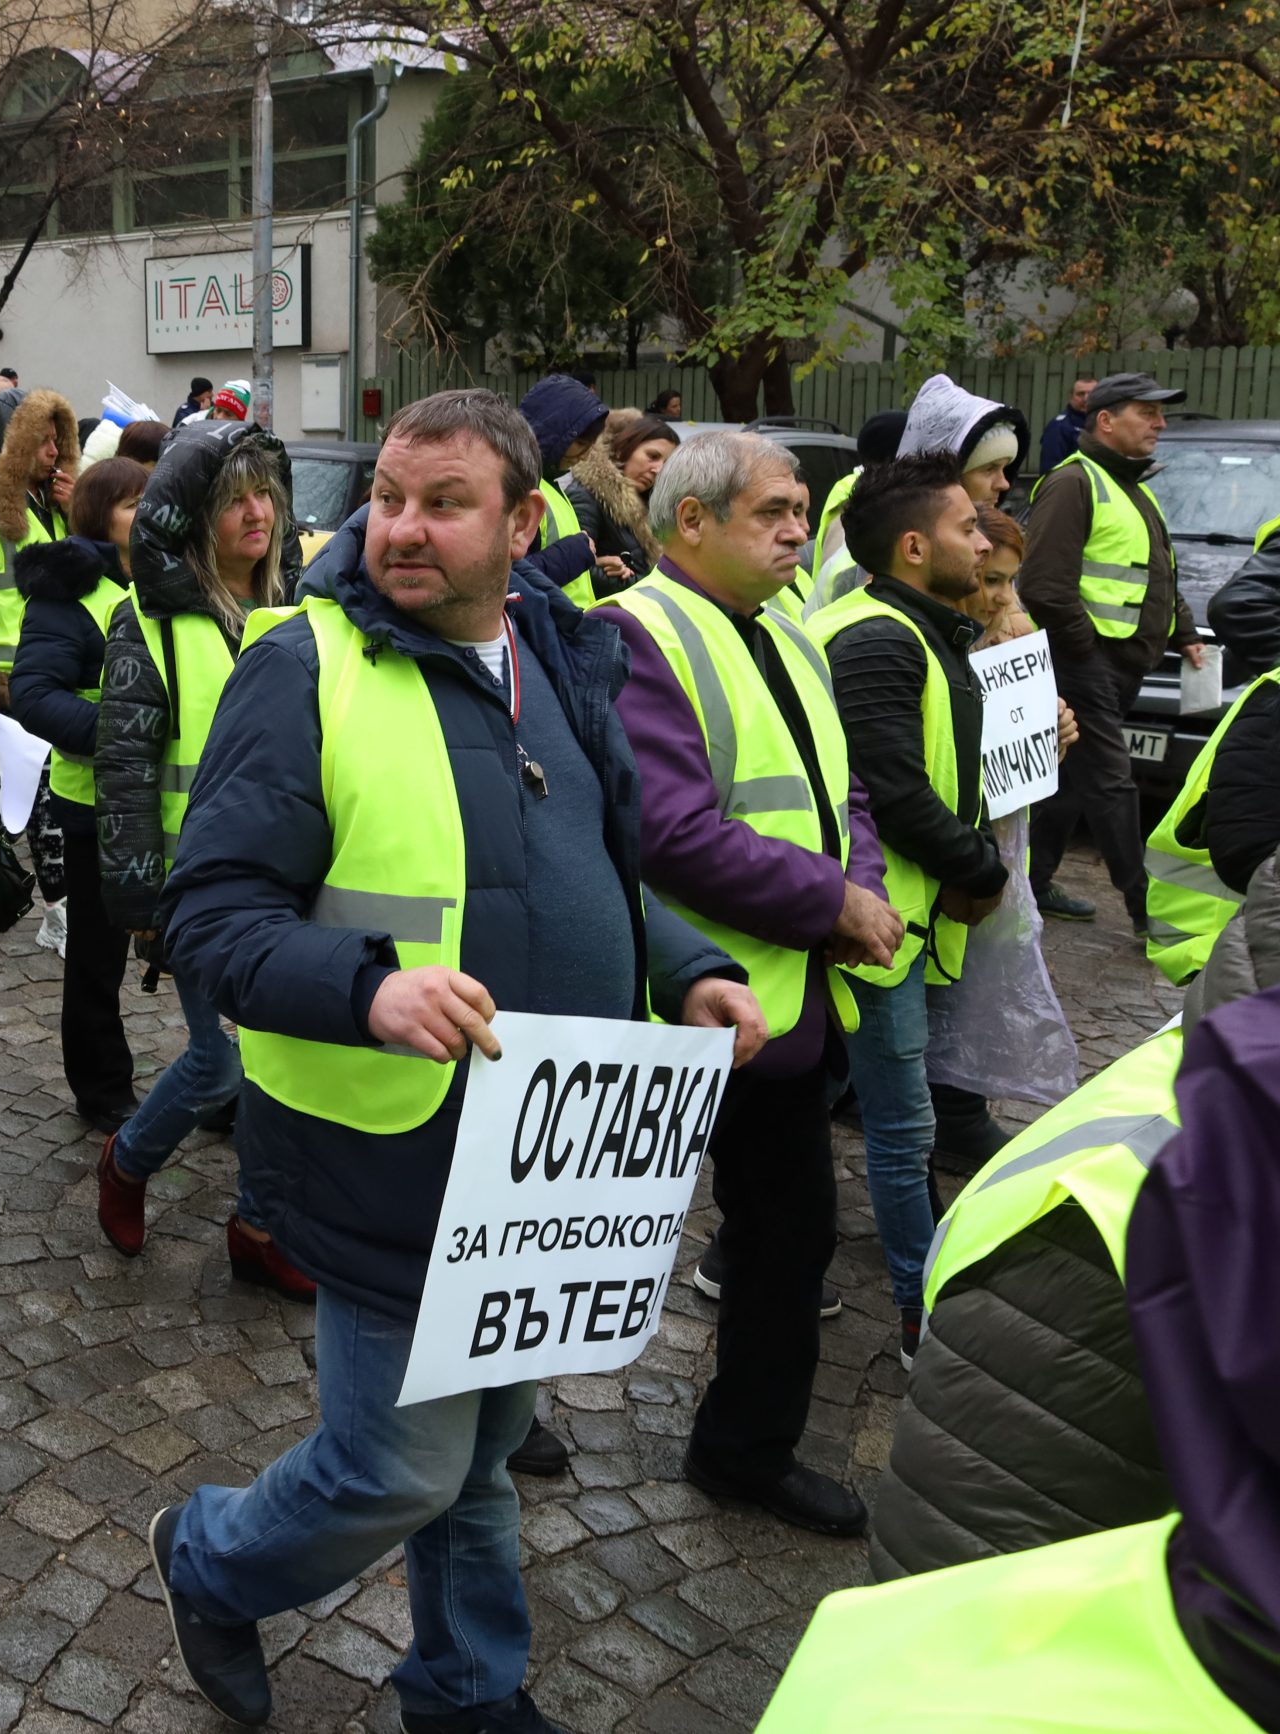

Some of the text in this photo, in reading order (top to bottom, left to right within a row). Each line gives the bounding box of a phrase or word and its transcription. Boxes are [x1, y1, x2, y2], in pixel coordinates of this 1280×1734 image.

[155, 270, 293, 320] ITALO
[155, 325, 200, 334] GUSTO
[1010, 706, 1024, 723] ОТ
[1130, 733, 1162, 756] MT
[510, 1059, 721, 1184] ОСТАВКА
[447, 1225, 488, 1263] ЗА
[469, 1272, 665, 1358] ВЪТЕВ!
